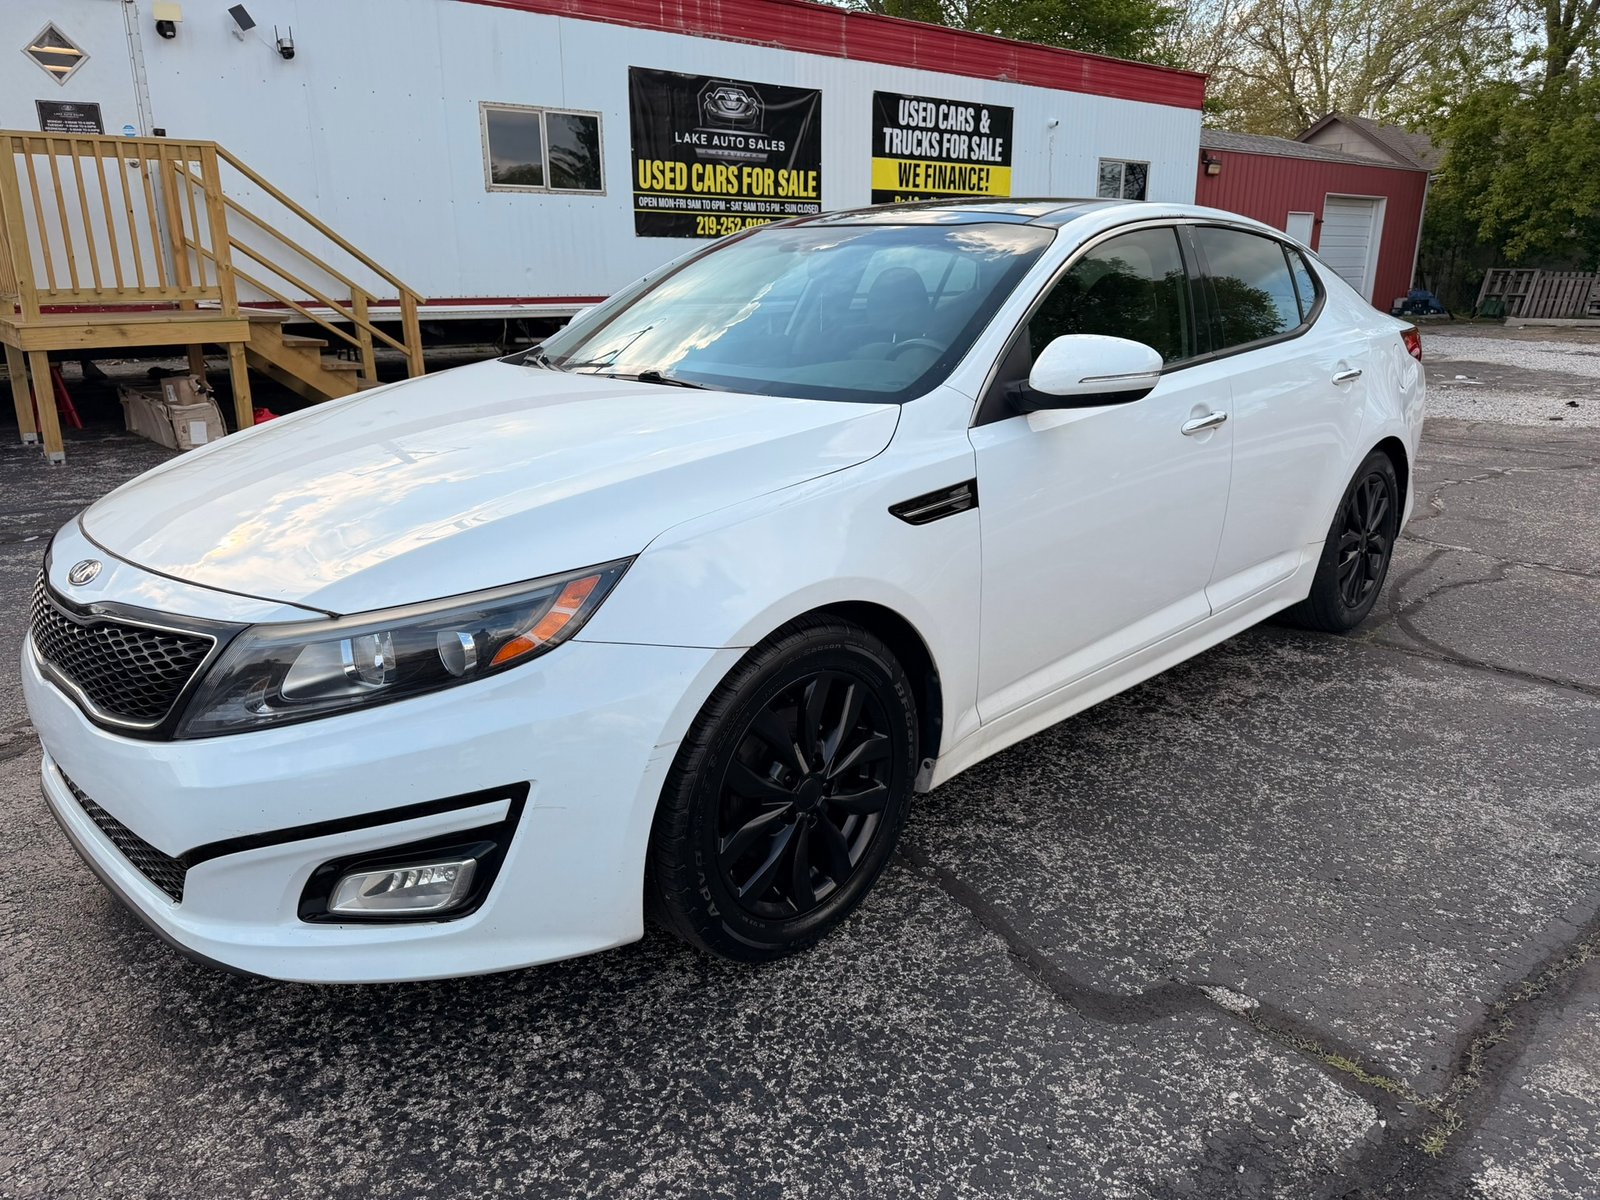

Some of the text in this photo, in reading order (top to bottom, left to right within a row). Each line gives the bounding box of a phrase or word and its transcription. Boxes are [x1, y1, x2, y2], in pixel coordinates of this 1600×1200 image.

[898, 99, 991, 133] USED CARS &
[675, 131, 785, 151] LAKE AUTO SALES
[883, 127, 1003, 162] TRUCKS FOR SALE
[638, 159, 817, 197] USED CARS FOR SALE
[898, 162, 990, 192] WE FINANCE!
[638, 196, 657, 207] OPEN
[658, 197, 686, 208] MON-FRI
[687, 199, 701, 209] 9AM
[702, 200, 711, 209] TO
[711, 200, 726, 210] 6PM
[730, 201, 742, 211] SAT
[743, 202, 756, 211] 9AM
[757, 202, 765, 212] TO
[766, 203, 770, 212] 5
[770, 203, 780, 212] PM
[784, 204, 797, 213] SUN
[797, 204, 819, 214] CLOSED
[696, 216, 771, 235] 219-252-
